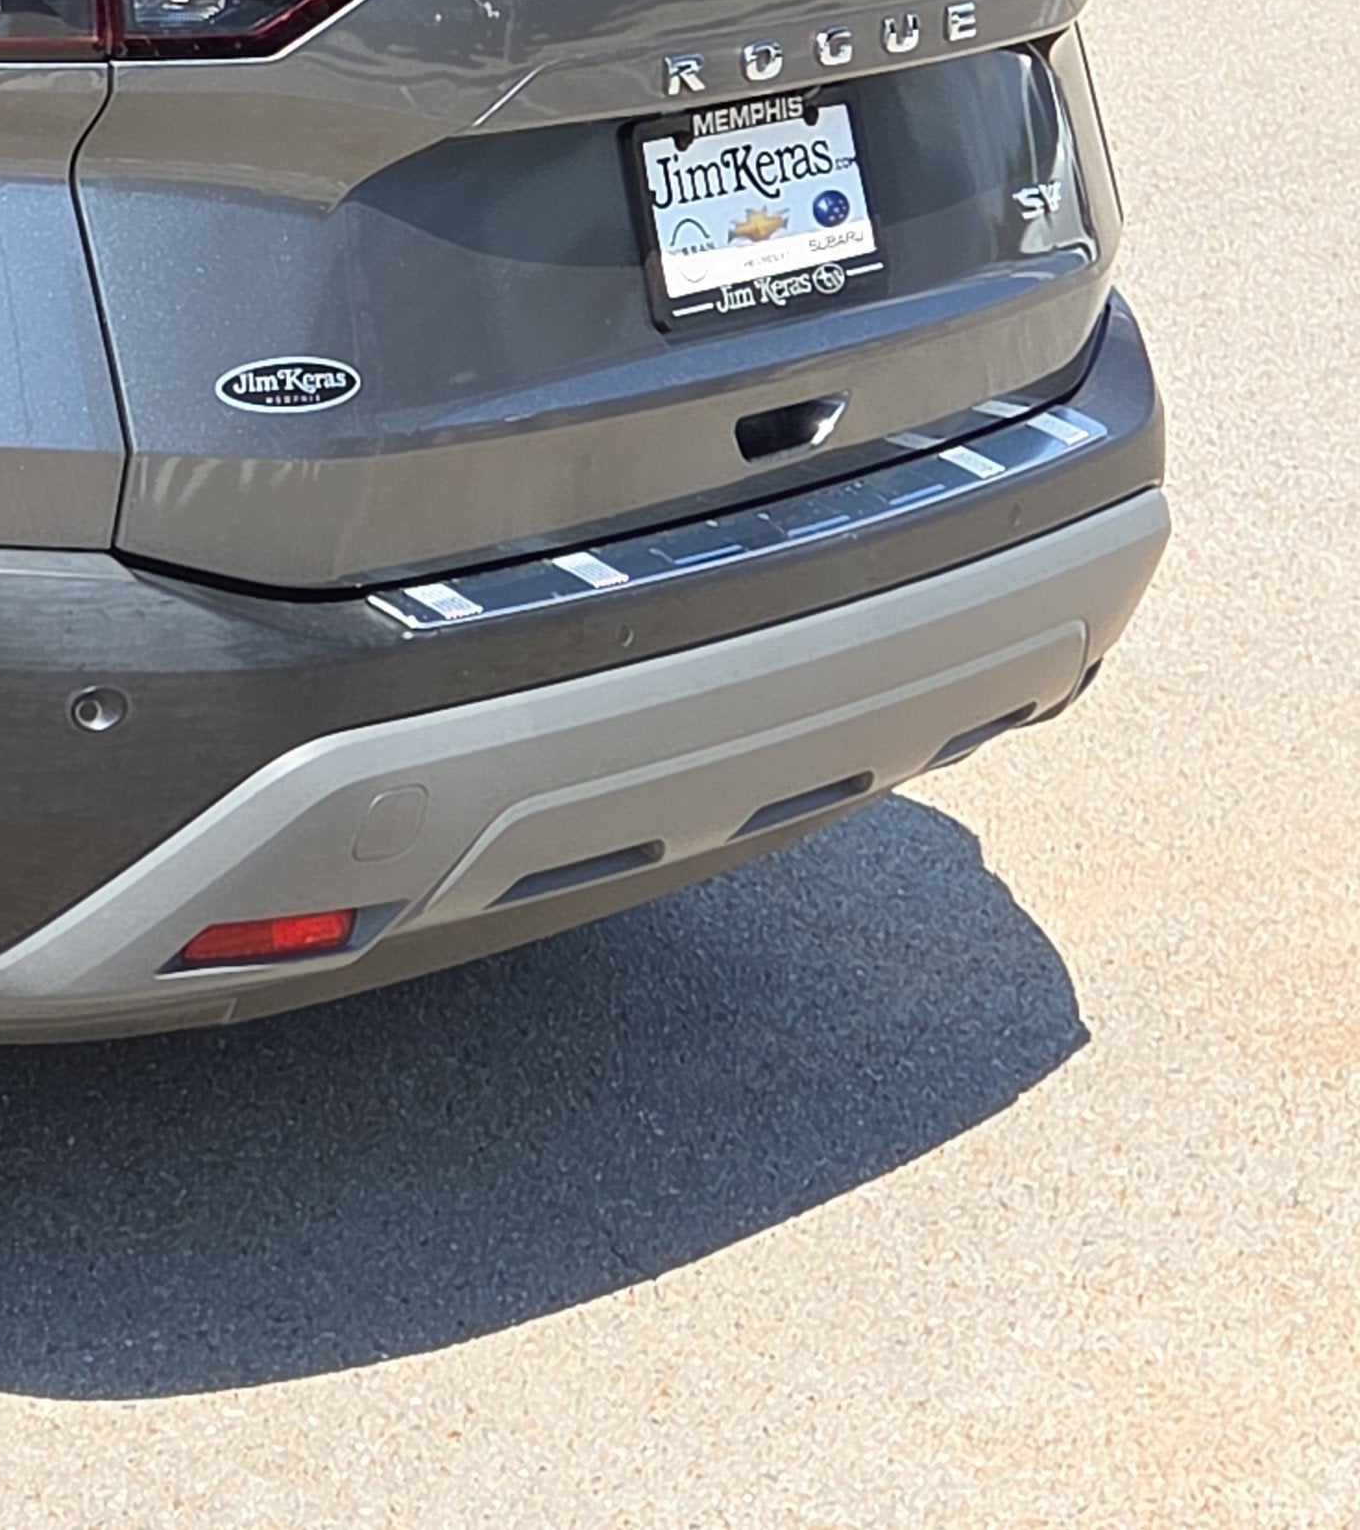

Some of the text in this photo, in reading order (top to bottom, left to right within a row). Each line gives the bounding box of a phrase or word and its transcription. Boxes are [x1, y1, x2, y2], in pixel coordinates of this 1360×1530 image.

[663, 1, 978, 96] ROGUE
[692, 95, 804, 137] MEMPHIS
[1011, 181, 1062, 220] SV
[715, 273, 813, 313] Jim Keras
